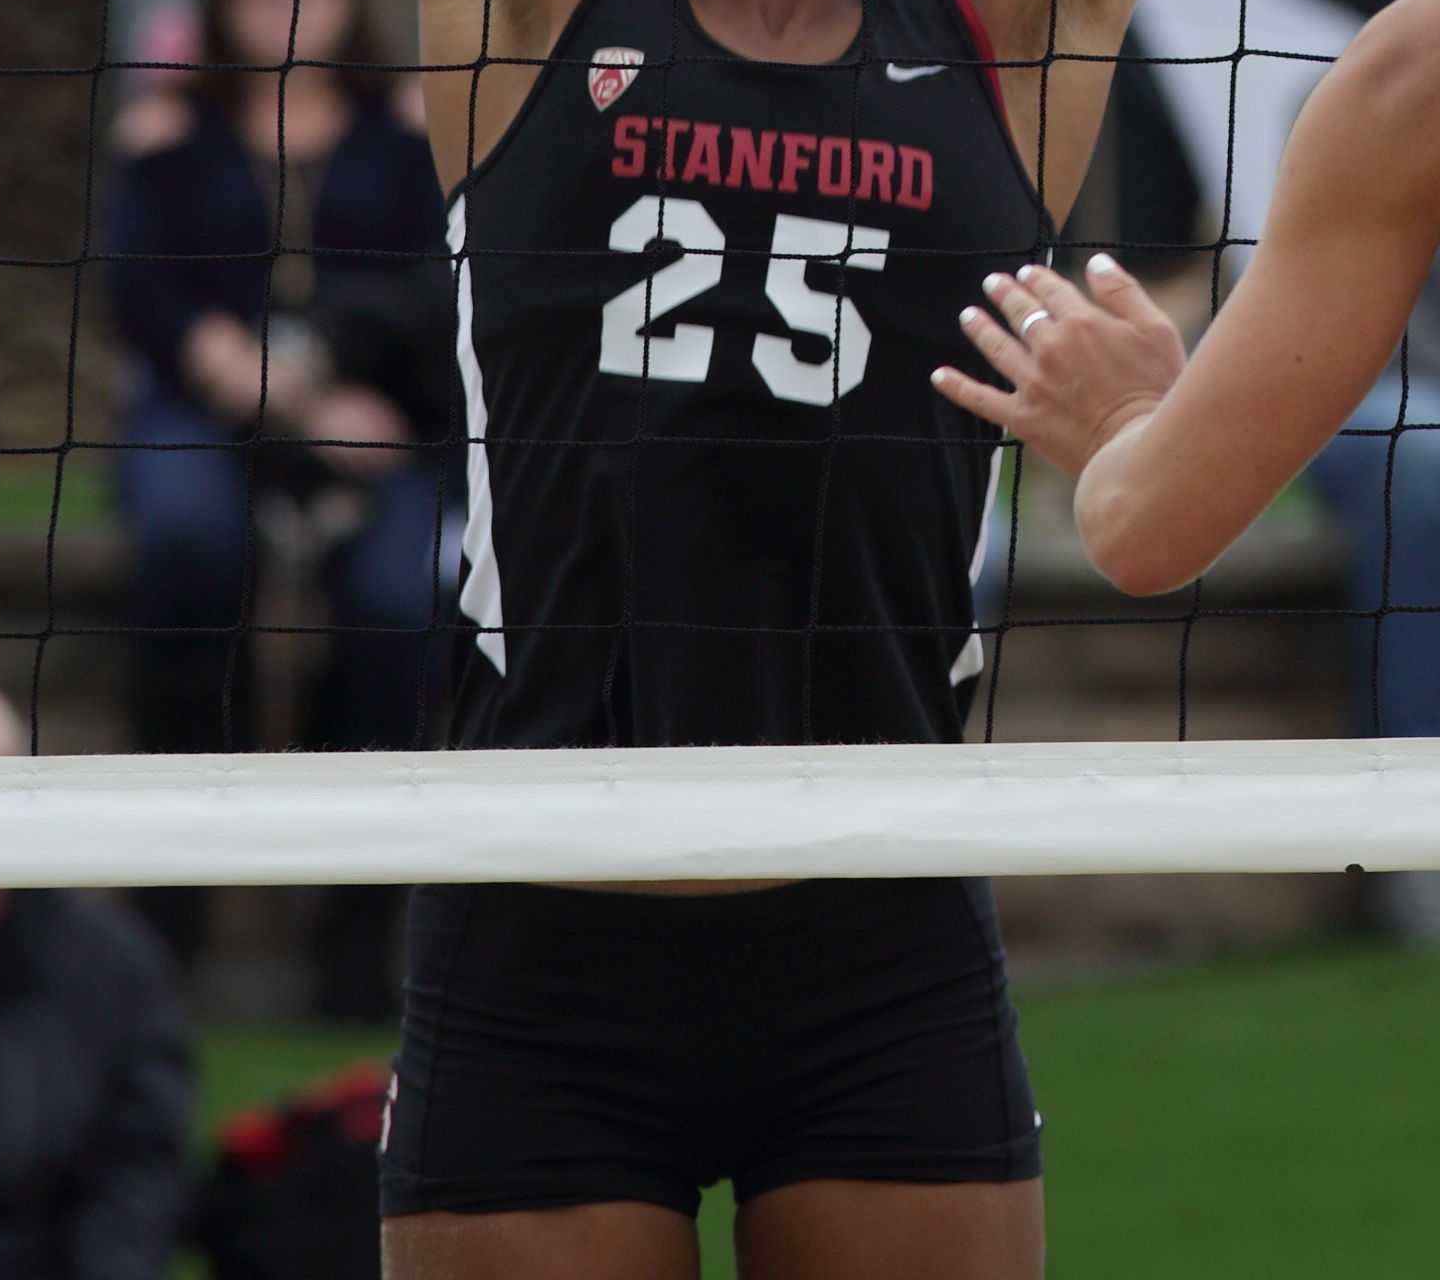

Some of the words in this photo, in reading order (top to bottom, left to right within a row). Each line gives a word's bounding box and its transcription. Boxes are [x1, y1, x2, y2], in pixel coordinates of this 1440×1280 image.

[596, 78, 619, 100] 12
[611, 114, 934, 211] STANFORD
[598, 193, 891, 408] 25
